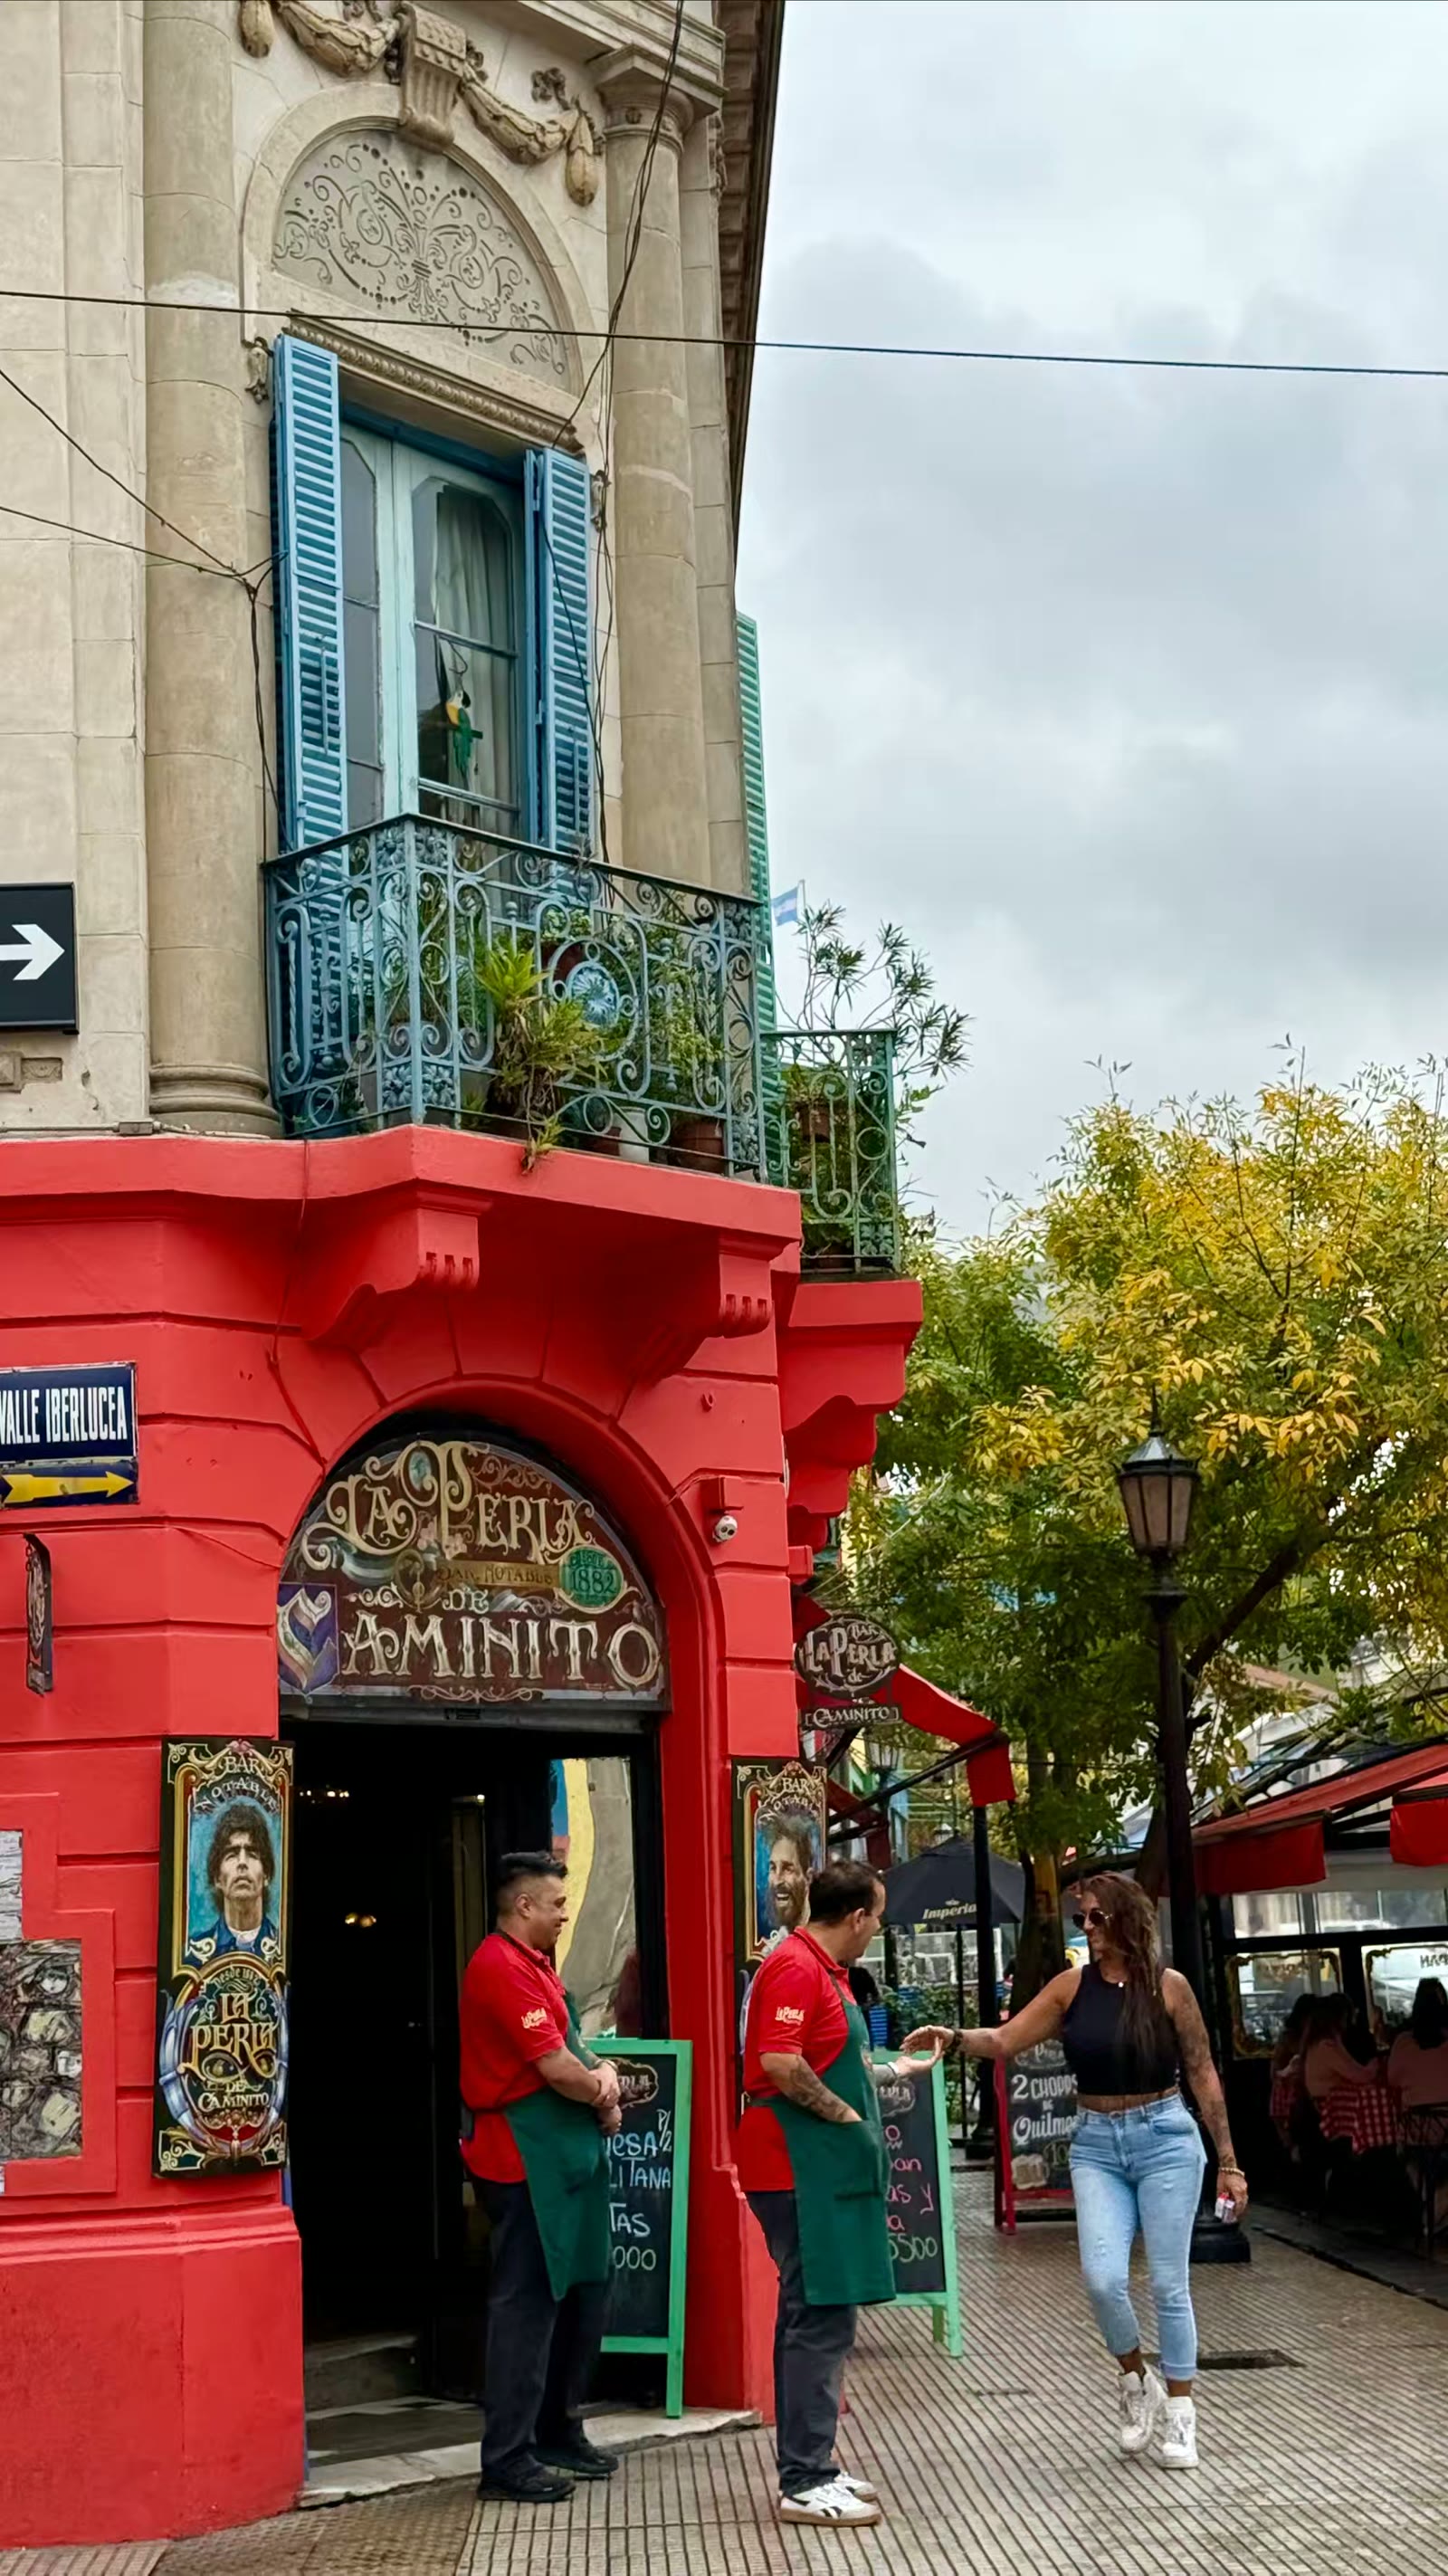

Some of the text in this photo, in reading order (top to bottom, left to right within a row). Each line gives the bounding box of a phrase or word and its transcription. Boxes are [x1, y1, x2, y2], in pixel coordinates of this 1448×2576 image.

[0, 1387, 128, 1445] VALLE IBERLUCEA
[302, 1441, 595, 1569] LA PERLA
[572, 1569, 618, 1594] 1882
[442, 1589, 490, 1615] DE
[277, 1588, 661, 1693] CAMINITO
[851, 1623, 879, 1637] BAR
[805, 1627, 896, 1677] LA PERLA
[813, 1707, 891, 1728] CAMINITO
[224, 1755, 261, 1774] BAR
[193, 1777, 278, 1812] NOTABLE
[782, 1777, 808, 1793] BAR
[922, 1903, 977, 1920] Imperia
[220, 1992, 253, 2024] LA
[177, 2021, 277, 2081] PERLA
[225, 2080, 248, 2093] DE
[1012, 2074, 1030, 2100] 2
[198, 2092, 270, 2113] CAMINITO
[609, 2156, 672, 2190] LITANA
[609, 2202, 651, 2237] TAS
[613, 2246, 657, 2271] 000
